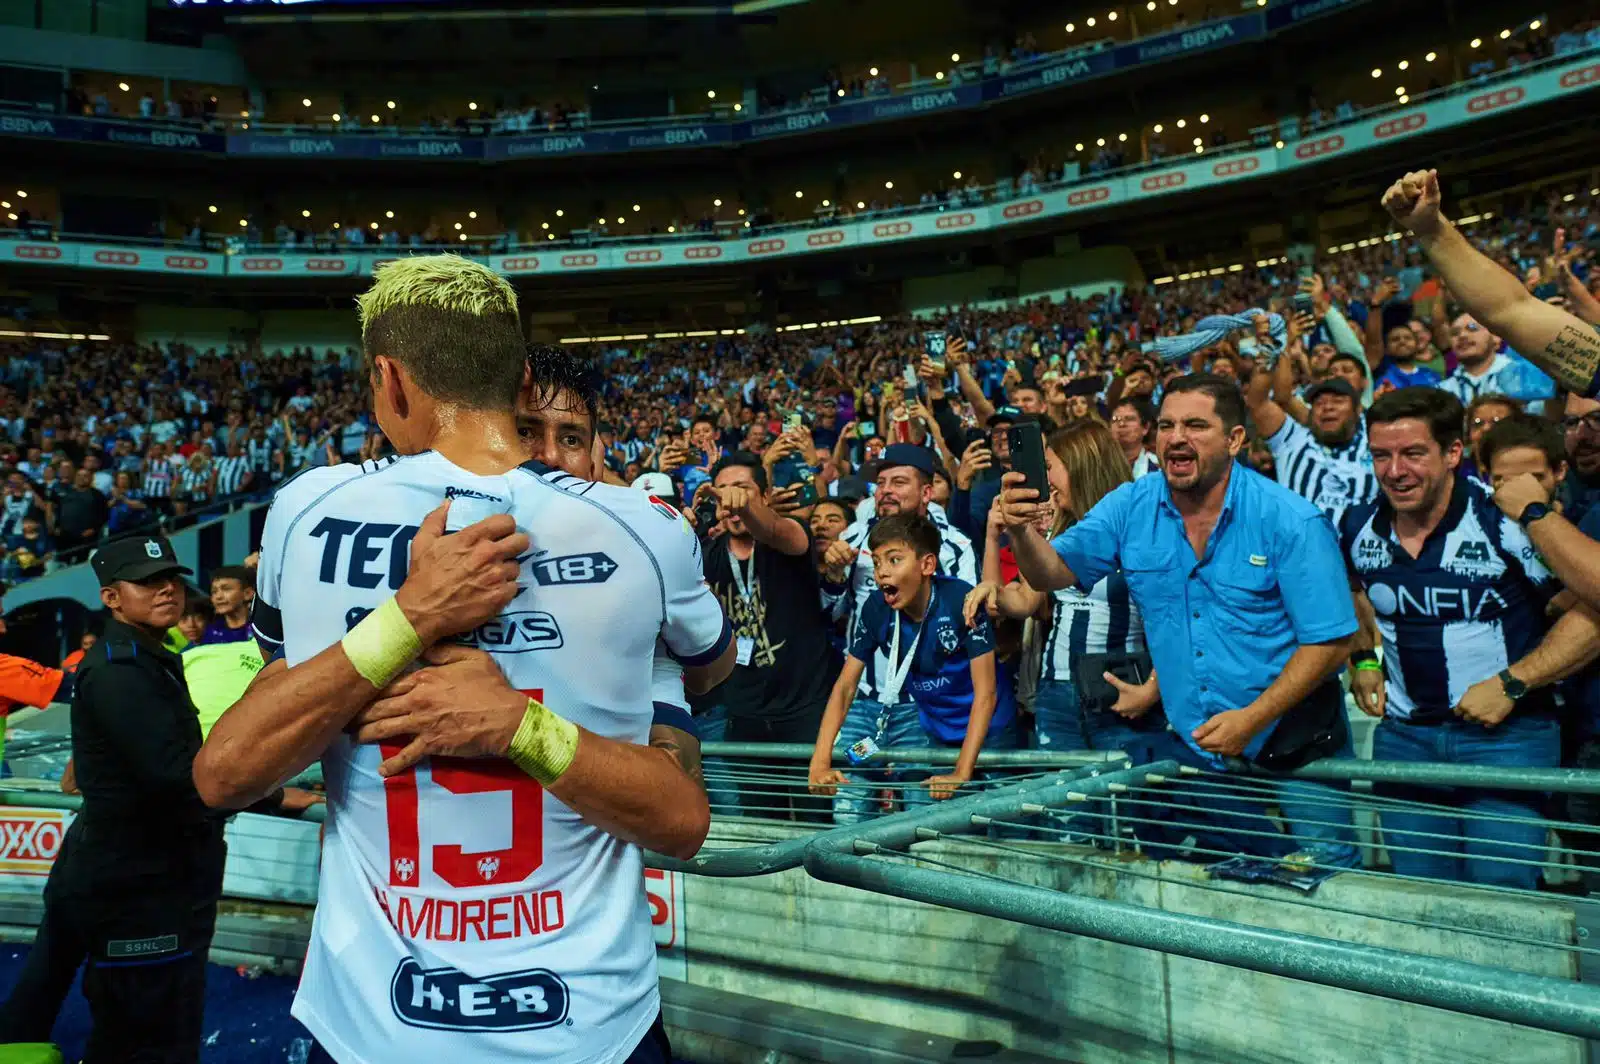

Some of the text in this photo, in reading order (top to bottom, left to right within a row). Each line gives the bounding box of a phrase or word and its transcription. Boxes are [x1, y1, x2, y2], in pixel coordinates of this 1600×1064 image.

[1180, 23, 1233, 49] BBVA
[1041, 60, 1088, 85] BBVA
[911, 92, 957, 110] BBVA
[786, 111, 830, 130] BBVA
[151, 131, 200, 147] BBVA
[542, 136, 584, 152] BBVA
[664, 128, 707, 144] BBVA
[418, 142, 463, 155] BBVA
[1359, 538, 1382, 550] ABA
[536, 557, 615, 582] 18+
[912, 676, 951, 692] BBVA
[379, 688, 545, 888] 15
[0, 820, 61, 858] XXO
[125, 942, 159, 952] SSNL
